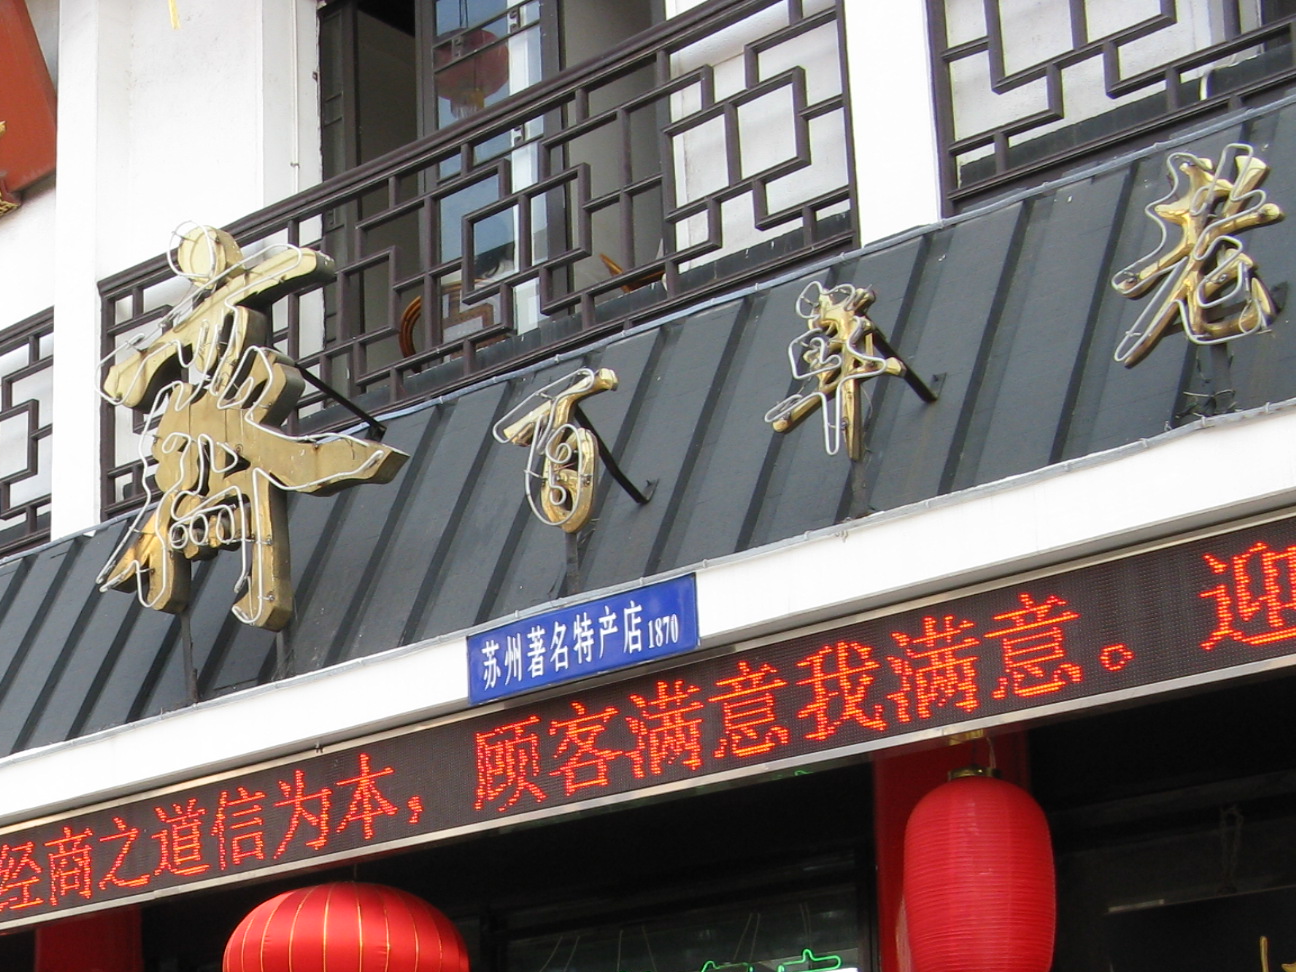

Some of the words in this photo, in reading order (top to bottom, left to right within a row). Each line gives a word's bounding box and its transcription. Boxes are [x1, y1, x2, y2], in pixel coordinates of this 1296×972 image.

[481, 600, 643, 690] 苏州著名特产店
[648, 614, 680, 649] 1870
